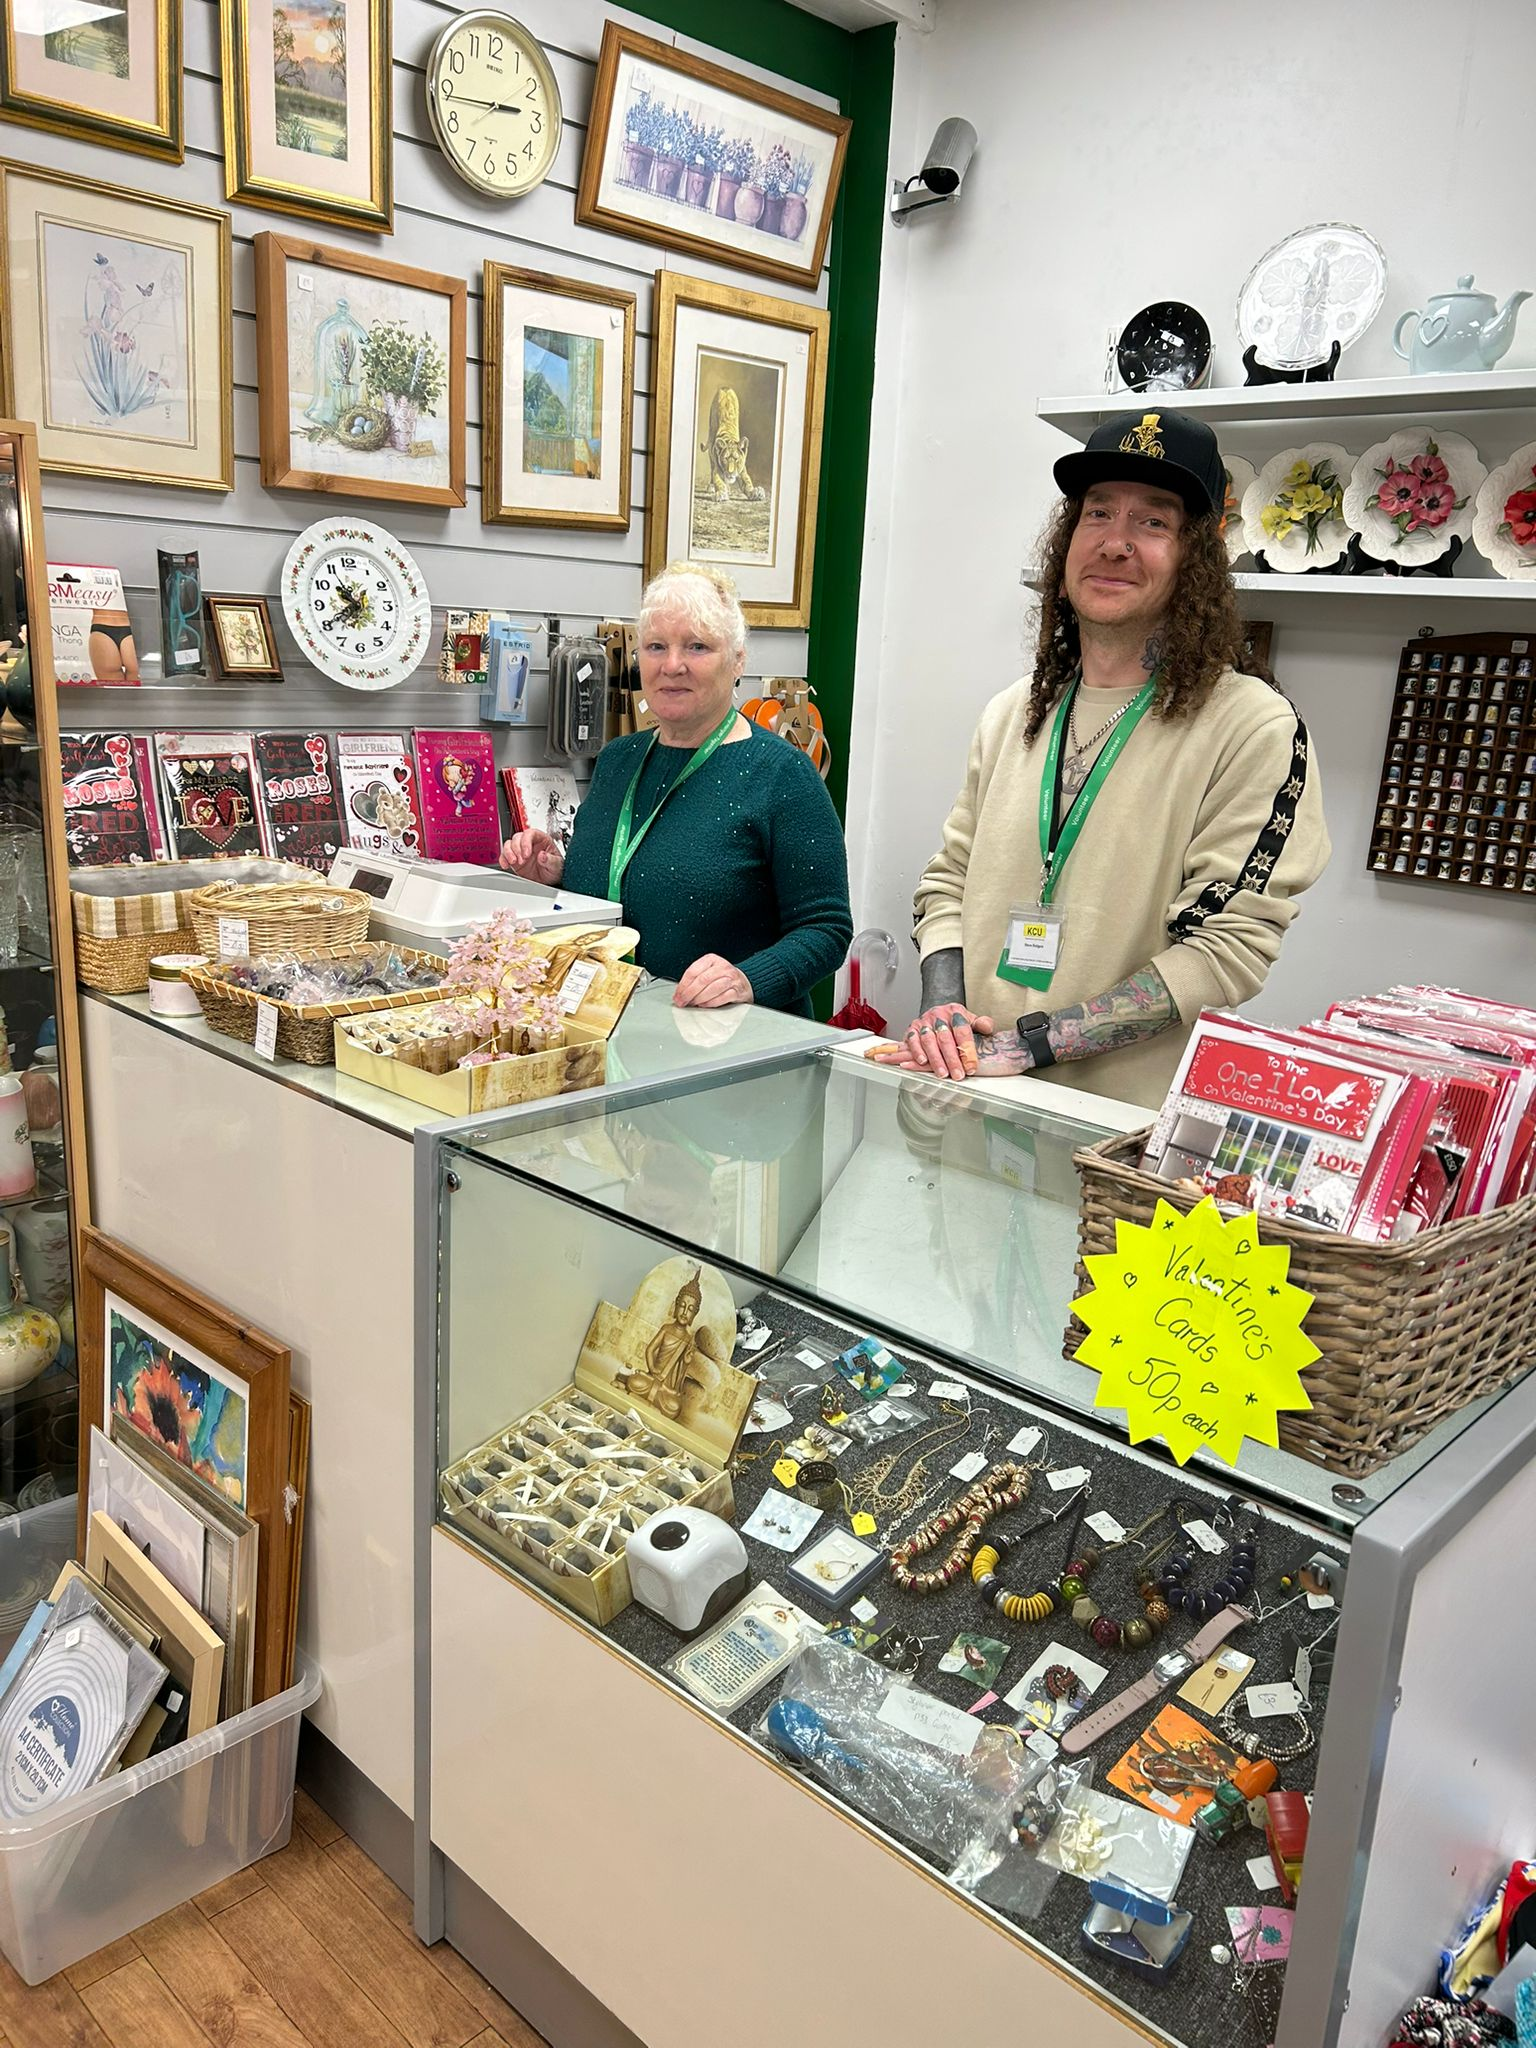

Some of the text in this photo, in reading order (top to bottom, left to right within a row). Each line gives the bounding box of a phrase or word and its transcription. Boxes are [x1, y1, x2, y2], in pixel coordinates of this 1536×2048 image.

[469, 33, 480, 59] 11
[487, 33, 503, 61] 12
[449, 48, 465, 75] 10
[486, 64, 503, 74] SEIKO
[514, 51, 520, 74] 1
[441, 78, 454, 101] 9
[525, 77, 537, 101] 2
[447, 111, 459, 134] 8
[530, 110, 542, 134] 3
[465, 137, 477, 161] 7
[522, 140, 534, 161] 4
[483, 153, 496, 175] 6
[505, 152, 518, 175] 5
[327, 564, 336, 575] 11
[340, 557, 357, 568] 12
[48, 583, 114, 606] RMeasy
[315, 579, 331, 591] 10
[376, 580, 388, 591] 2
[52, 598, 97, 606] erwear
[314, 599, 325, 611] 9
[382, 600, 394, 612] 3
[51, 624, 82, 637] NGA
[322, 620, 333, 632] 8
[380, 620, 392, 631] 4
[58, 636, 83, 646] Thong
[336, 636, 348, 647] 7
[355, 642, 366, 653] 6
[373, 636, 384, 647] 5
[503, 640, 531, 649] ESTRID
[342, 743, 399, 753] GIRLFRIEND
[1100, 736, 1121, 768] Volunteer
[266, 774, 332, 801] ROSES
[174, 795, 255, 829] LOVE
[284, 802, 332, 822] RED
[1071, 793, 1090, 827] Volunteer
[81, 811, 140, 833] RED
[351, 834, 390, 850] Hugs
[1027, 927, 1043, 937] KCU
[1267, 1055, 1310, 1077] To The
[1217, 1061, 1262, 1090] One
[1266, 1071, 1284, 1095] I
[1219, 1084, 1309, 1119] Valentine's
[1312, 1106, 1348, 1131] Day
[1316, 1151, 1363, 1176] LOVE
[1164, 1244, 1273, 1361] Valentine's
[1154, 1297, 1219, 1362] Cards
[1128, 1357, 1219, 1440] 50p each
[58, 1703, 76, 1729] Home
[14, 1750, 31, 1772] 21CM
[18, 1726, 66, 1788] A4 CERTIFICATE
